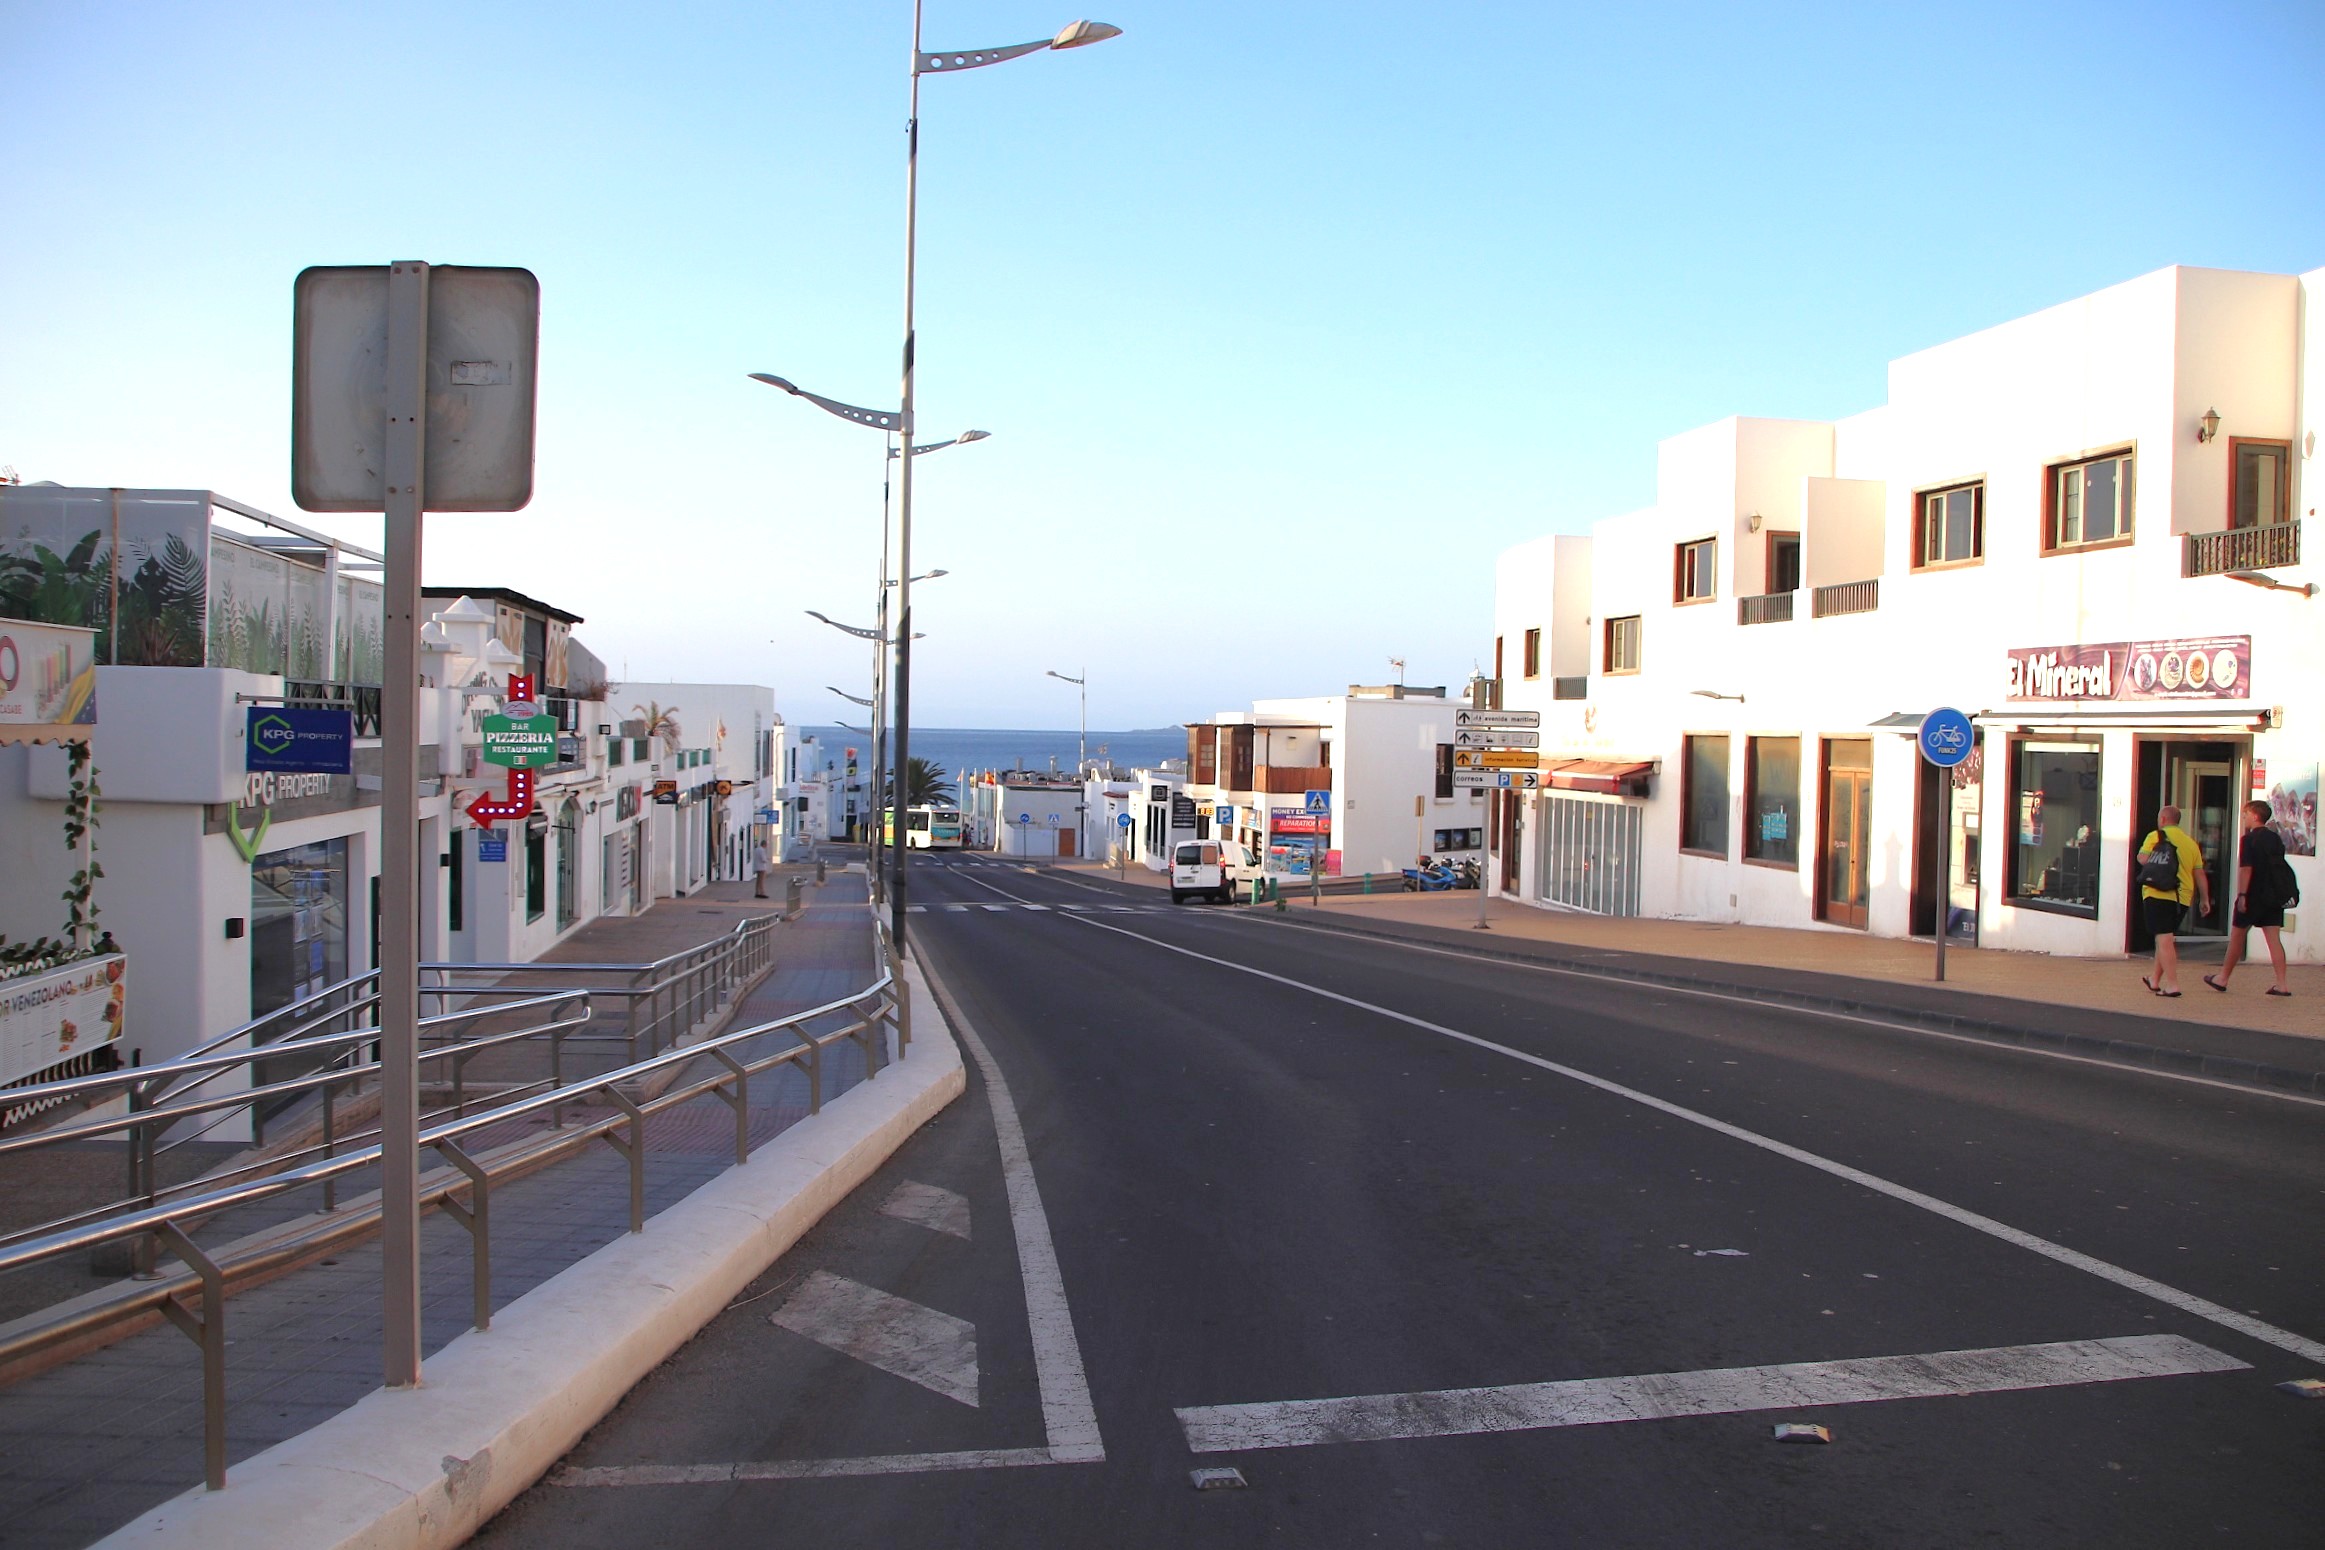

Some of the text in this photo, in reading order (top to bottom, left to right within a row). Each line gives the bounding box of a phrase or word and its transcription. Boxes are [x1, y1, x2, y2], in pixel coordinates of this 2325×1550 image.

[2006, 650, 2113, 697] El Mineral
[511, 723, 530, 731] BAR
[263, 729, 343, 741] KPG PROPERTY
[486, 732, 554, 744] PIZZERIA
[491, 745, 549, 754] RESTAURANTE
[240, 771, 332, 808] KPG PROPERTY
[11, 980, 73, 1011] VENEZOLANO
